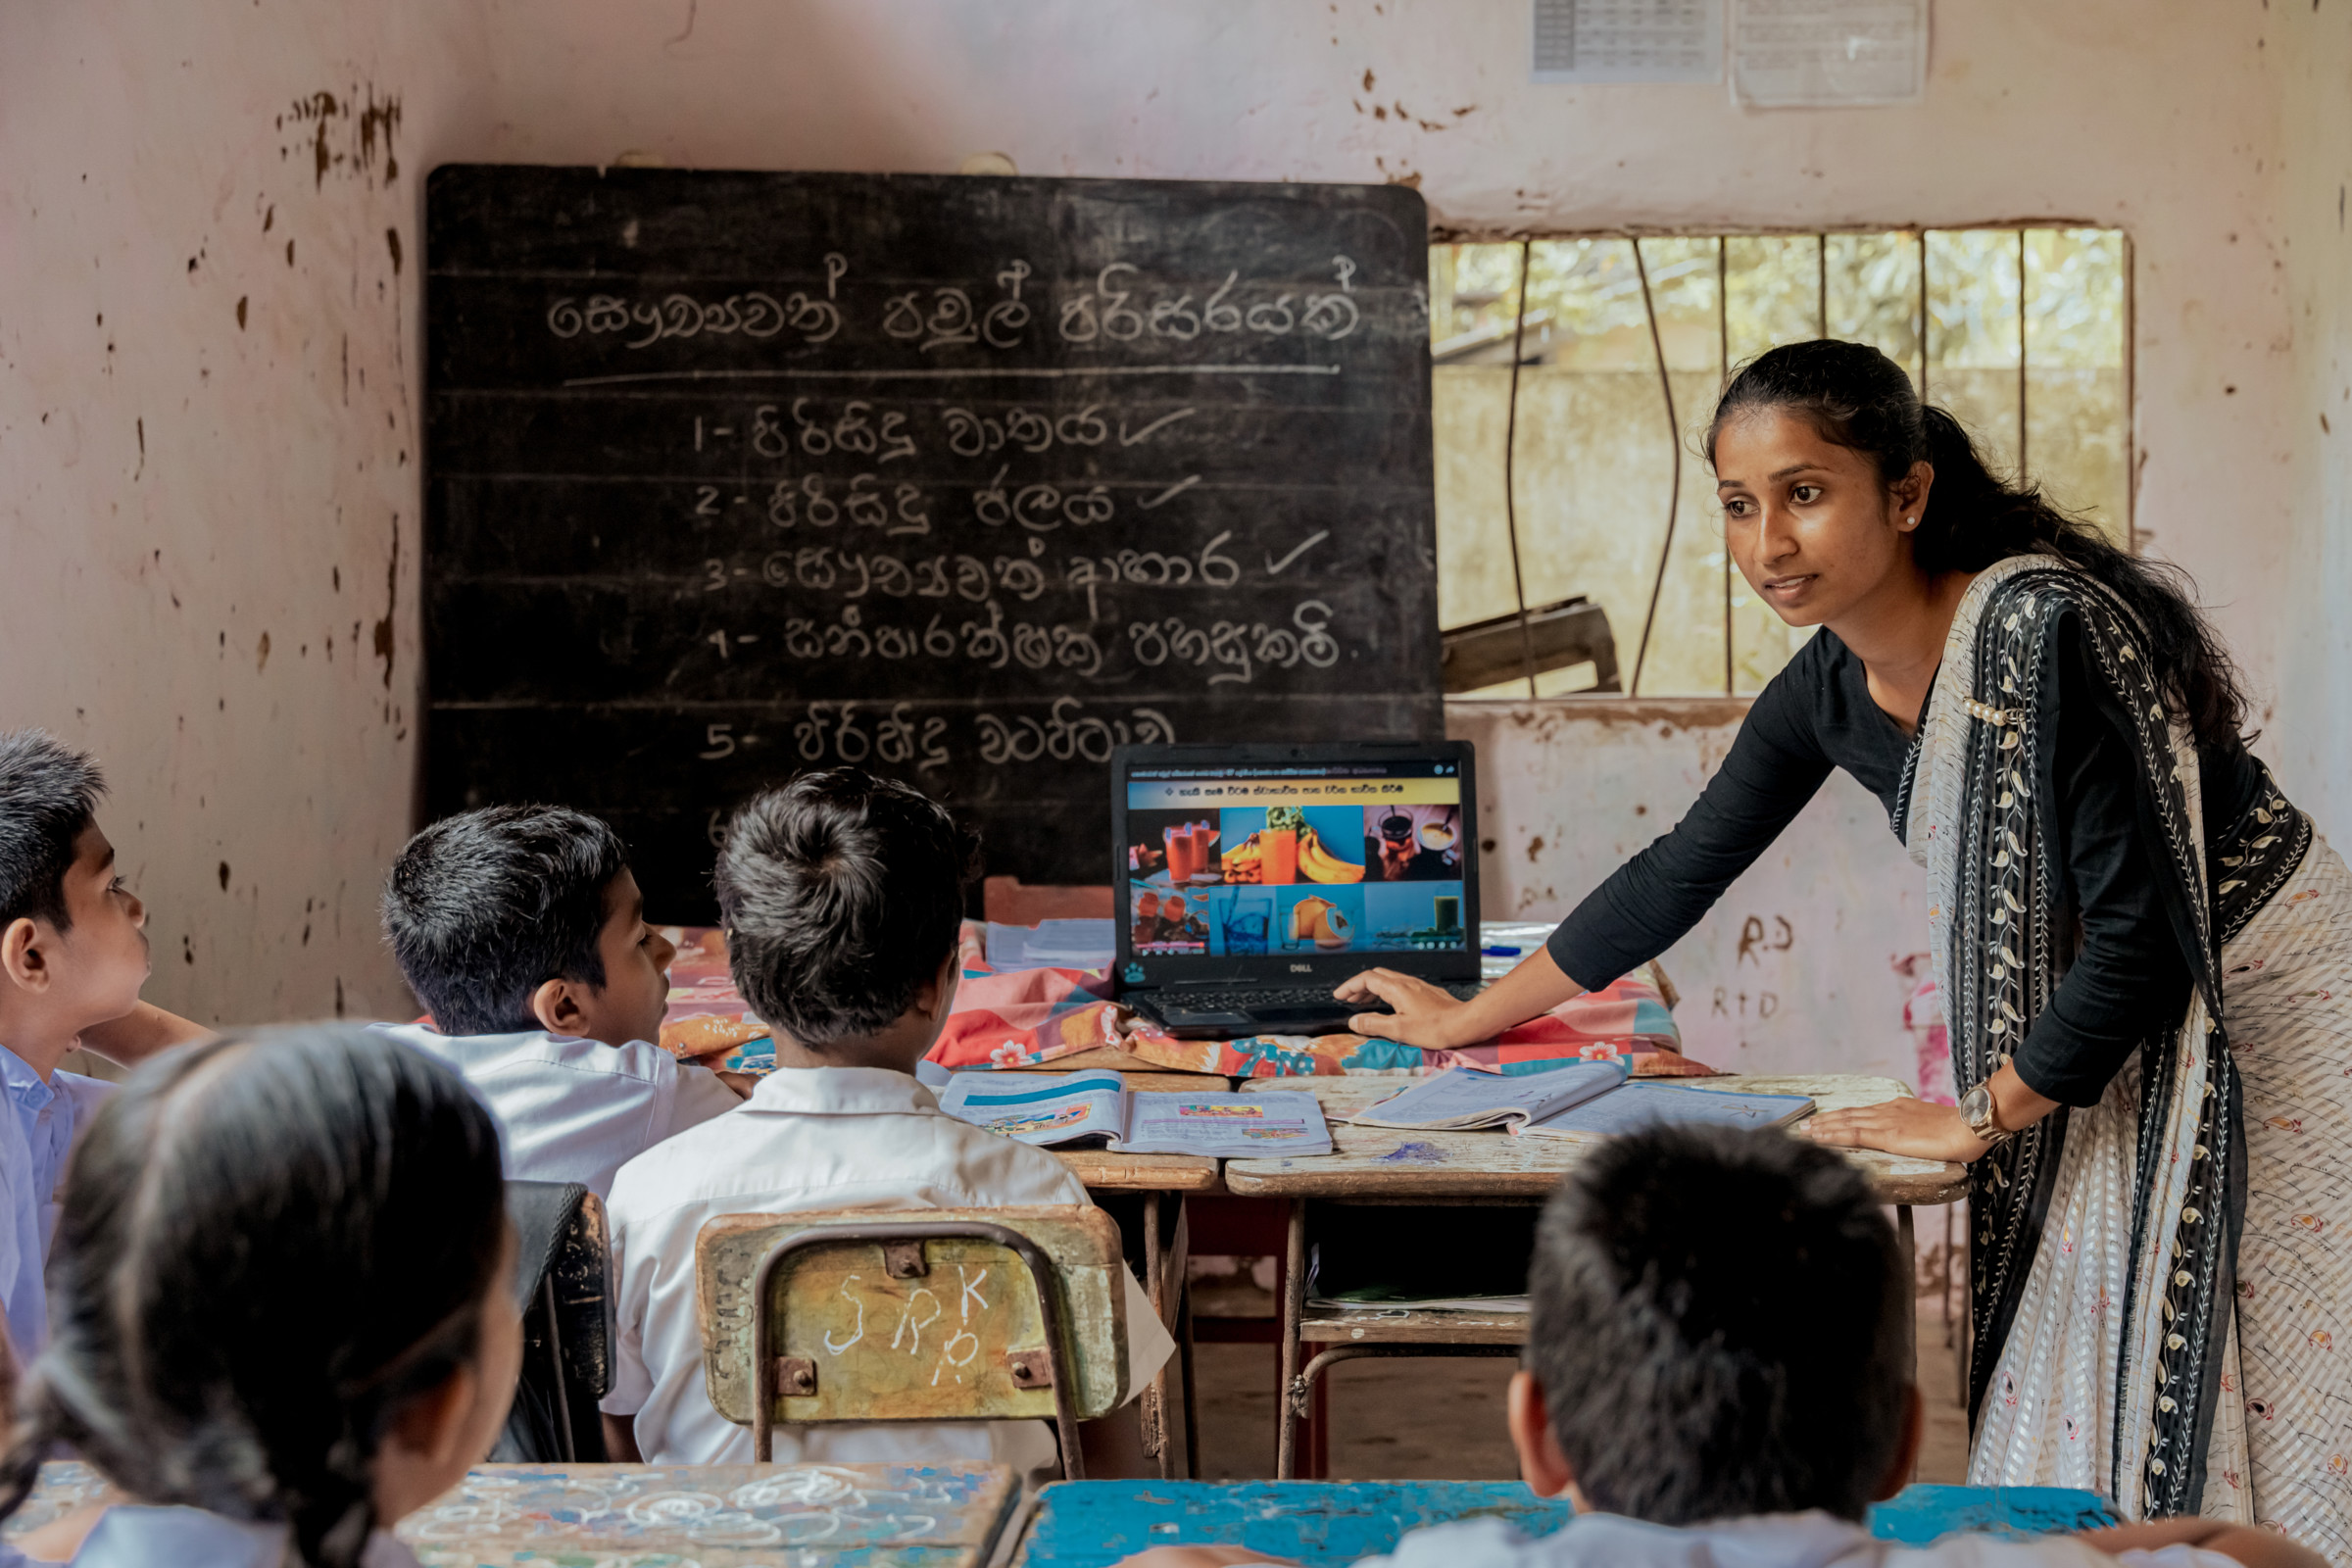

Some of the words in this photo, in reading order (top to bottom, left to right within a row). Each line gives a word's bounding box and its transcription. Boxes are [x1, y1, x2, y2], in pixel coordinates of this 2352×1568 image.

[1058, 255, 1361, 342] පරිසරයක්
[752, 397, 917, 465] පිරිසිදු
[942, 405, 1107, 459] වාතය
[766, 471, 934, 537] පිරිසිදු
[973, 463, 1115, 532] ජලය
[1290, 963, 1313, 973] DELL
